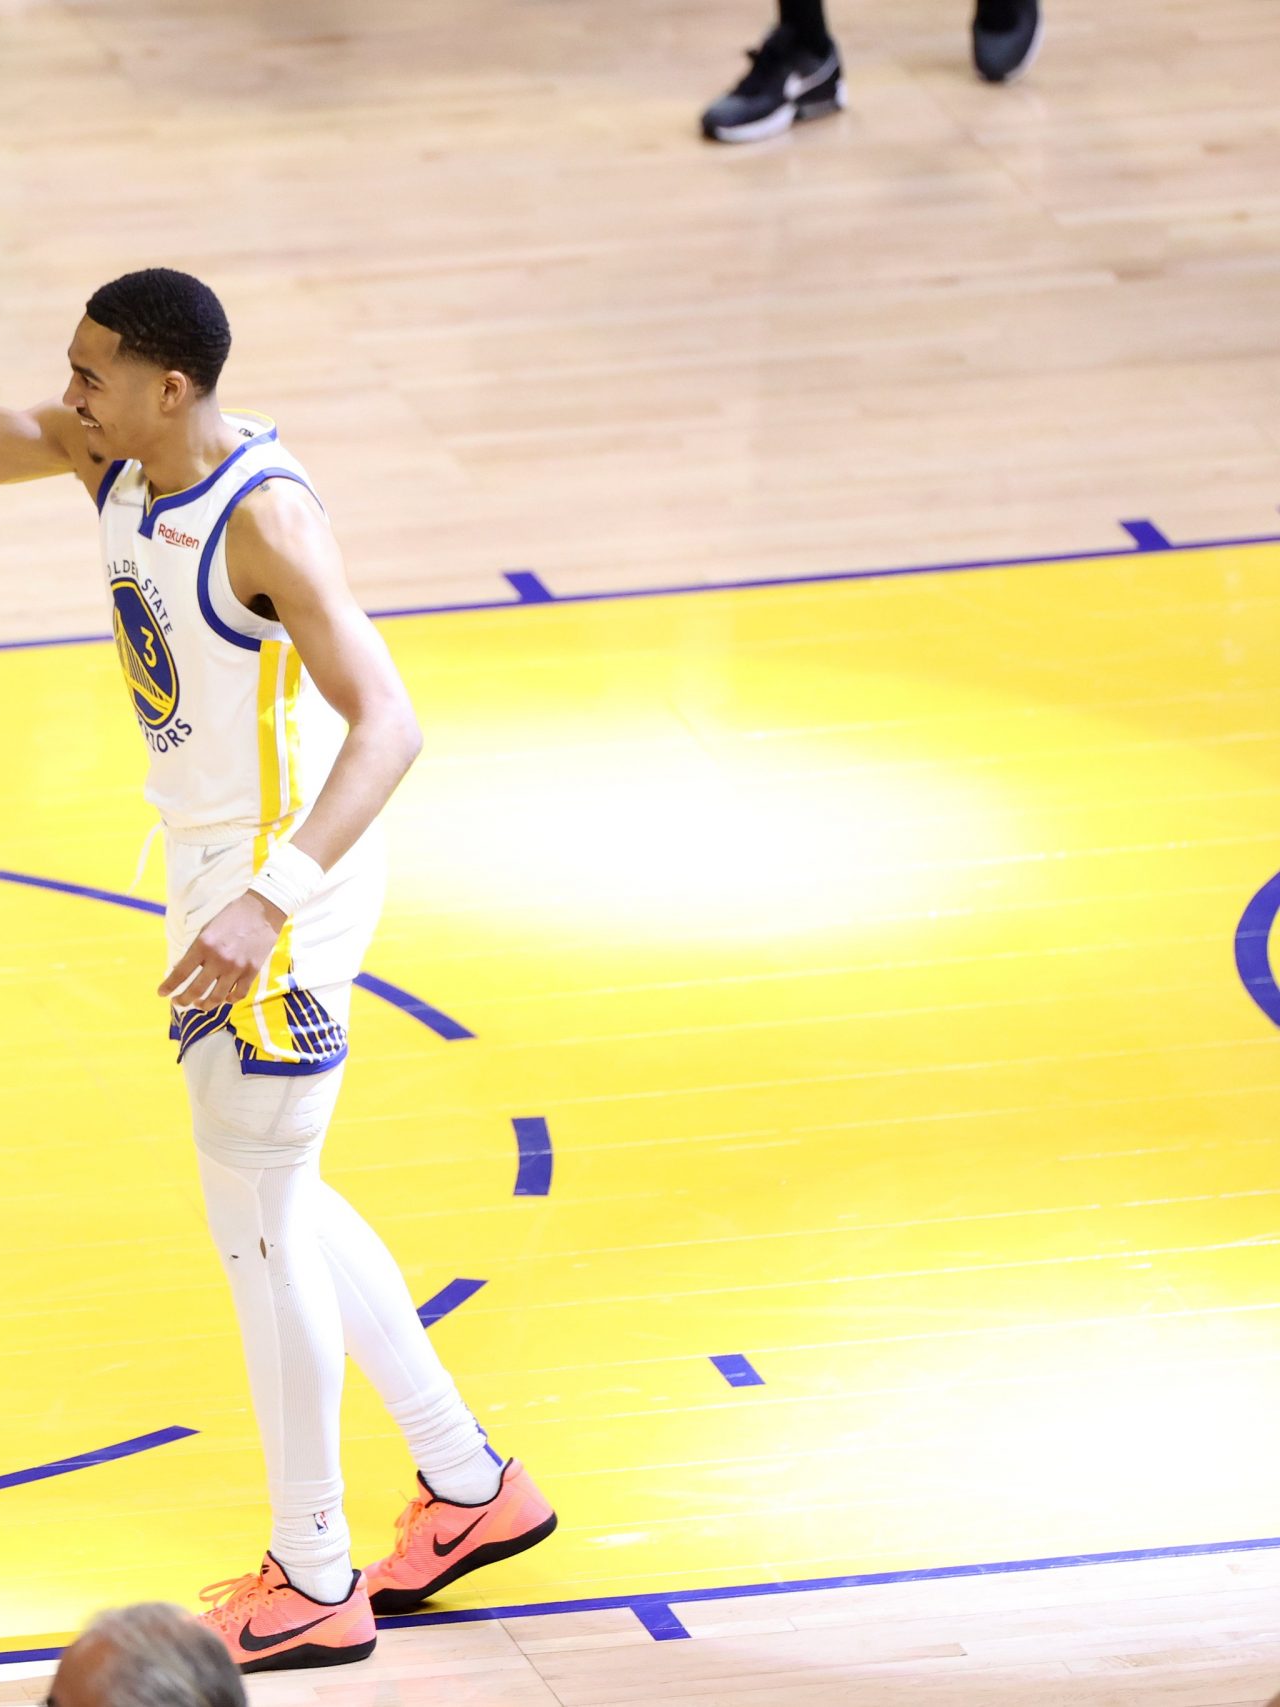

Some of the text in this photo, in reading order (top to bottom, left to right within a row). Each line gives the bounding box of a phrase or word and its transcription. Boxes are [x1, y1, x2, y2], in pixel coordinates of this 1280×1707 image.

[158, 523, 200, 550] Rakuten
[141, 578, 173, 635] STATE
[140, 626, 158, 668] 3
